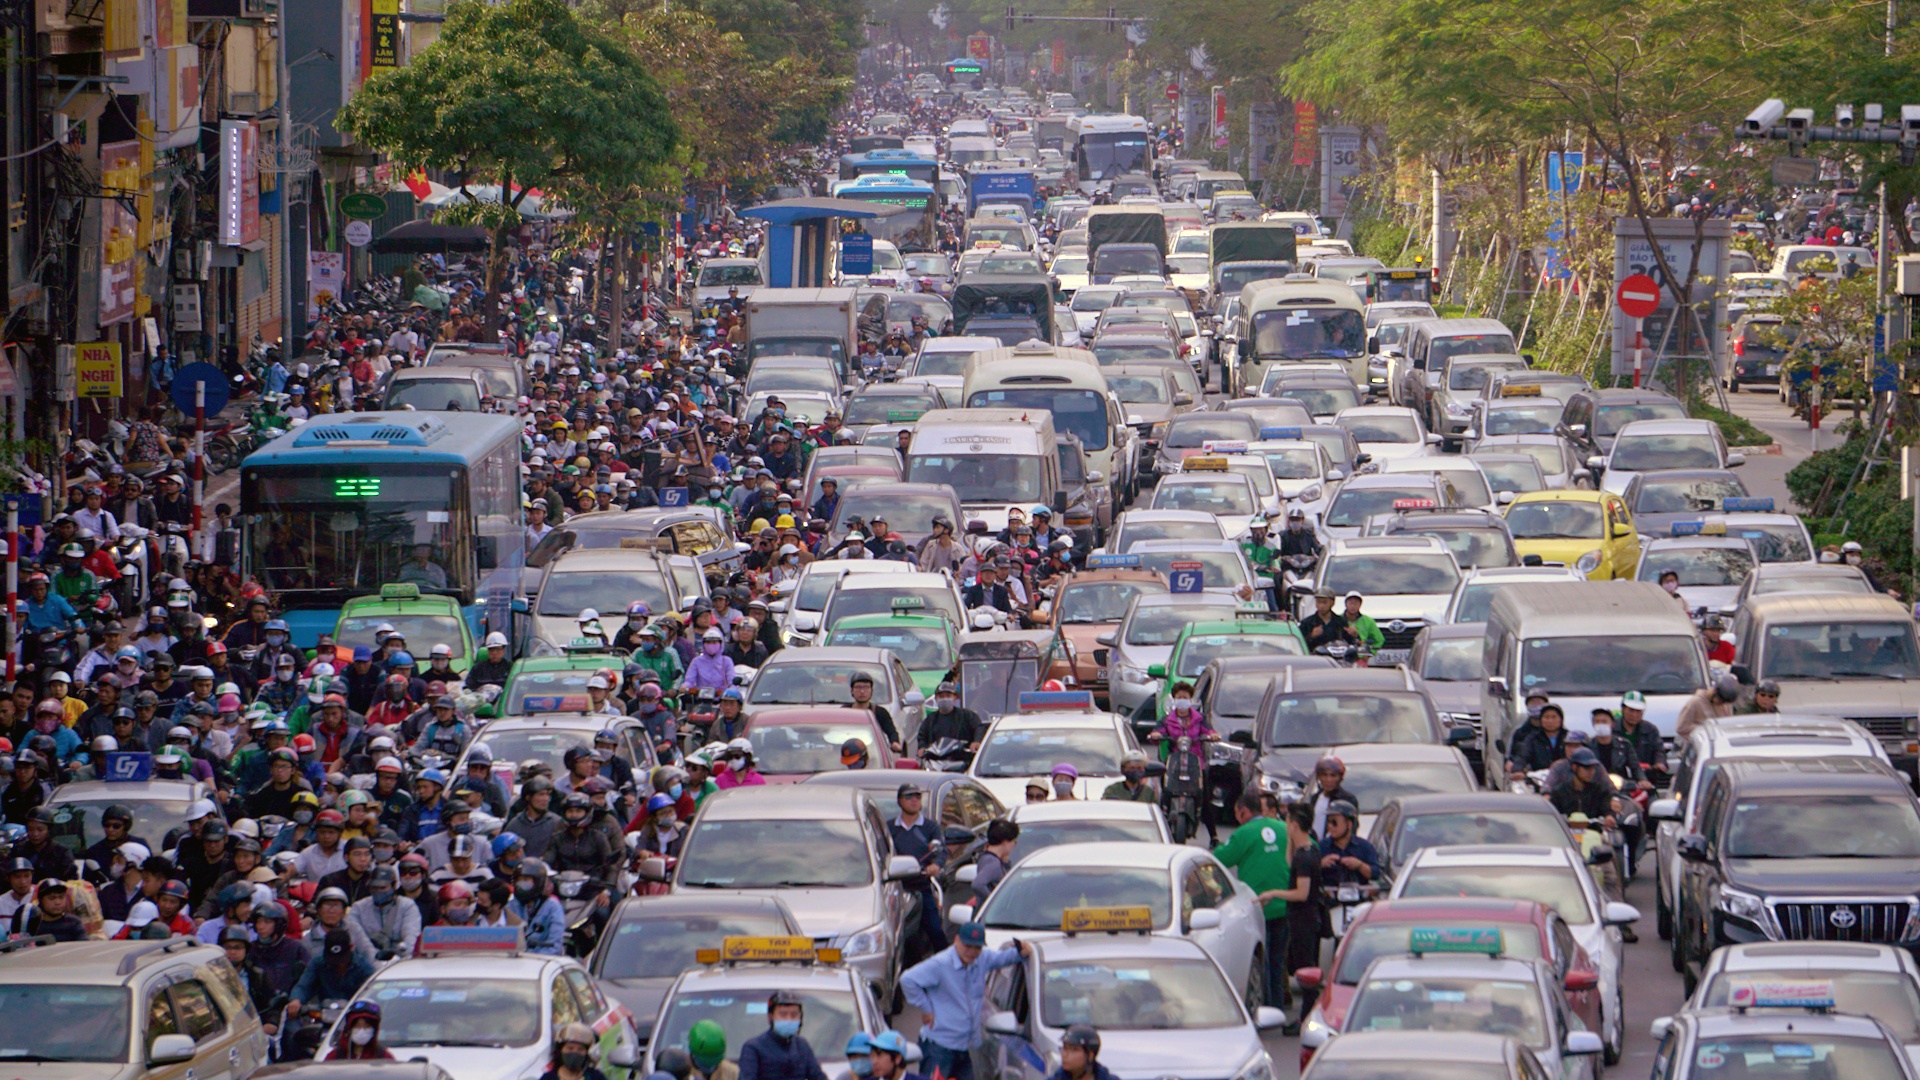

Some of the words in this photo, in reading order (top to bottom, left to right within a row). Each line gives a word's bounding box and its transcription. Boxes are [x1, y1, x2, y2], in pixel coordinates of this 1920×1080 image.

[379, 35, 390, 47] &
[374, 57, 395, 65] PHIM
[1333, 150, 1355, 166] 30
[82, 346, 112, 361] NHÀ
[81, 363, 115, 382] NGHỈ
[665, 489, 681, 505] G7
[1415, 499, 1435, 508] 123
[1177, 573, 1196, 591] G7
[572, 637, 597, 645] TAXI
[115, 755, 140, 778] G7
[769, 938, 791, 946] TAXI
[753, 948, 786, 956] THANH
